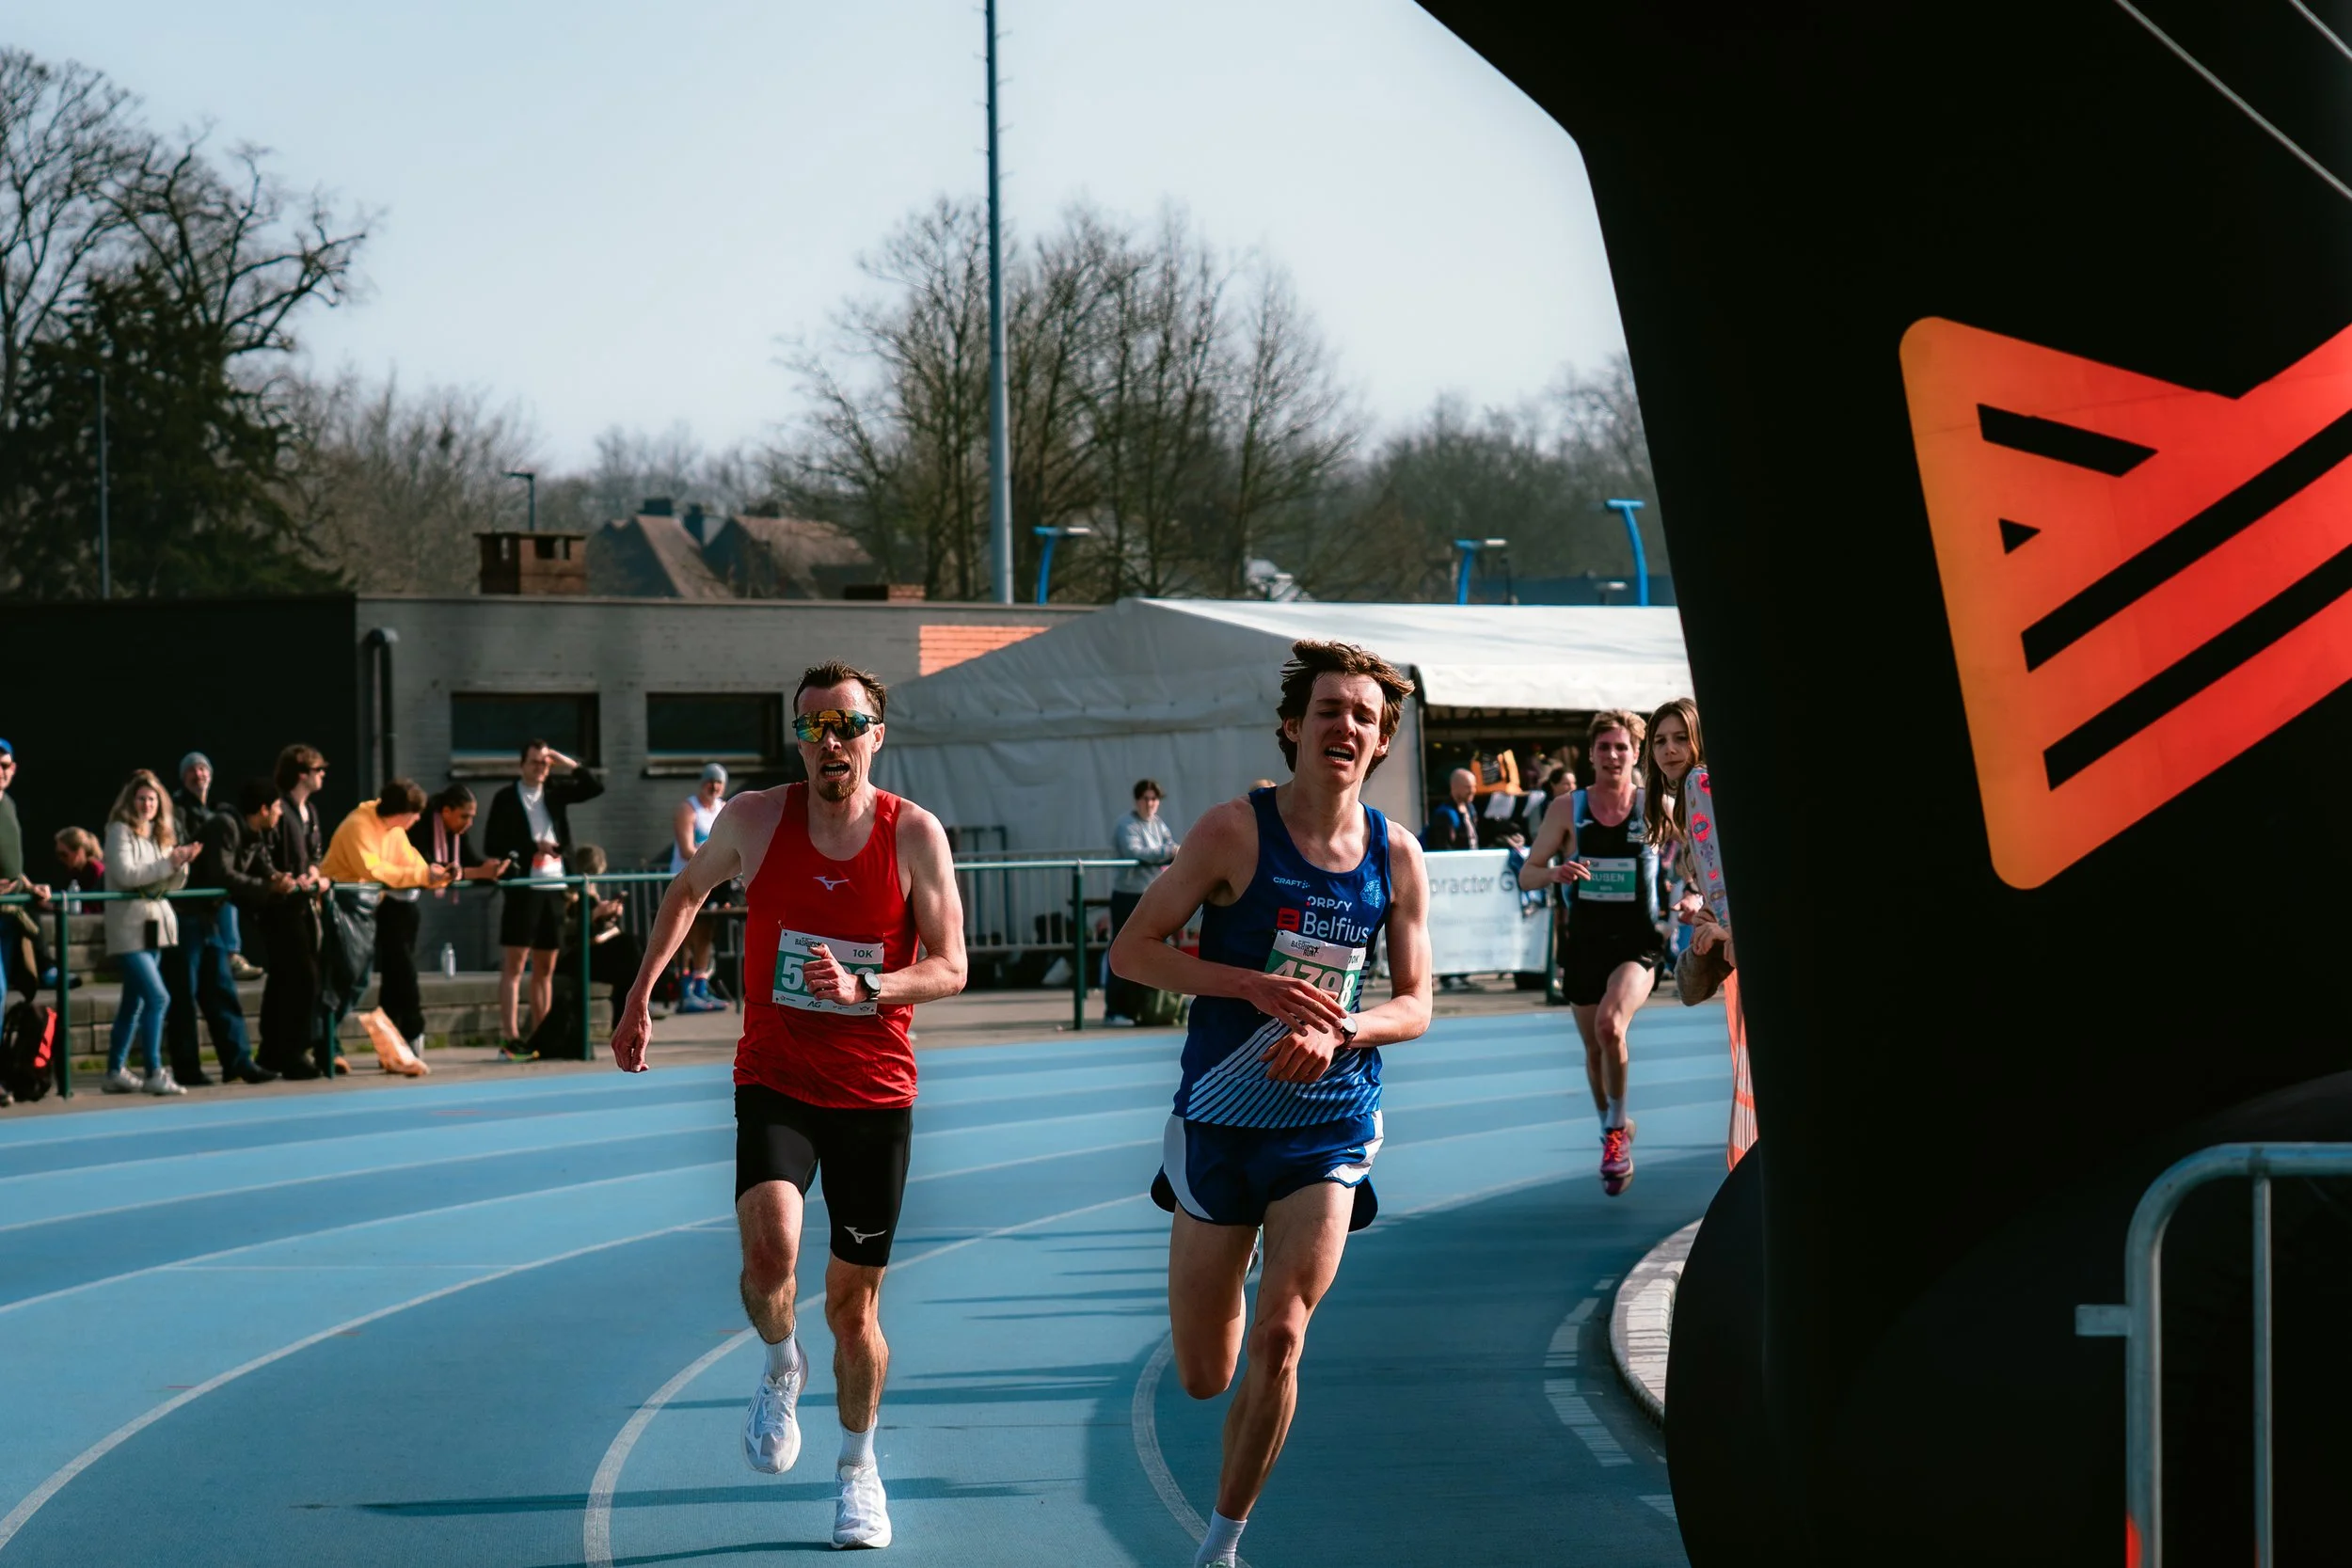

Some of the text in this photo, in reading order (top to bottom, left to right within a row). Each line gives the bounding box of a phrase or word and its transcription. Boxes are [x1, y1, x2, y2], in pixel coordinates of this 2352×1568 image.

[1273, 877, 1303, 887] CRAFT
[1590, 872, 1626, 883] RUBEN
[1306, 895, 1353, 911] ORPSY
[1302, 911, 1370, 942] Belfius
[852, 948, 874, 958] 10K
